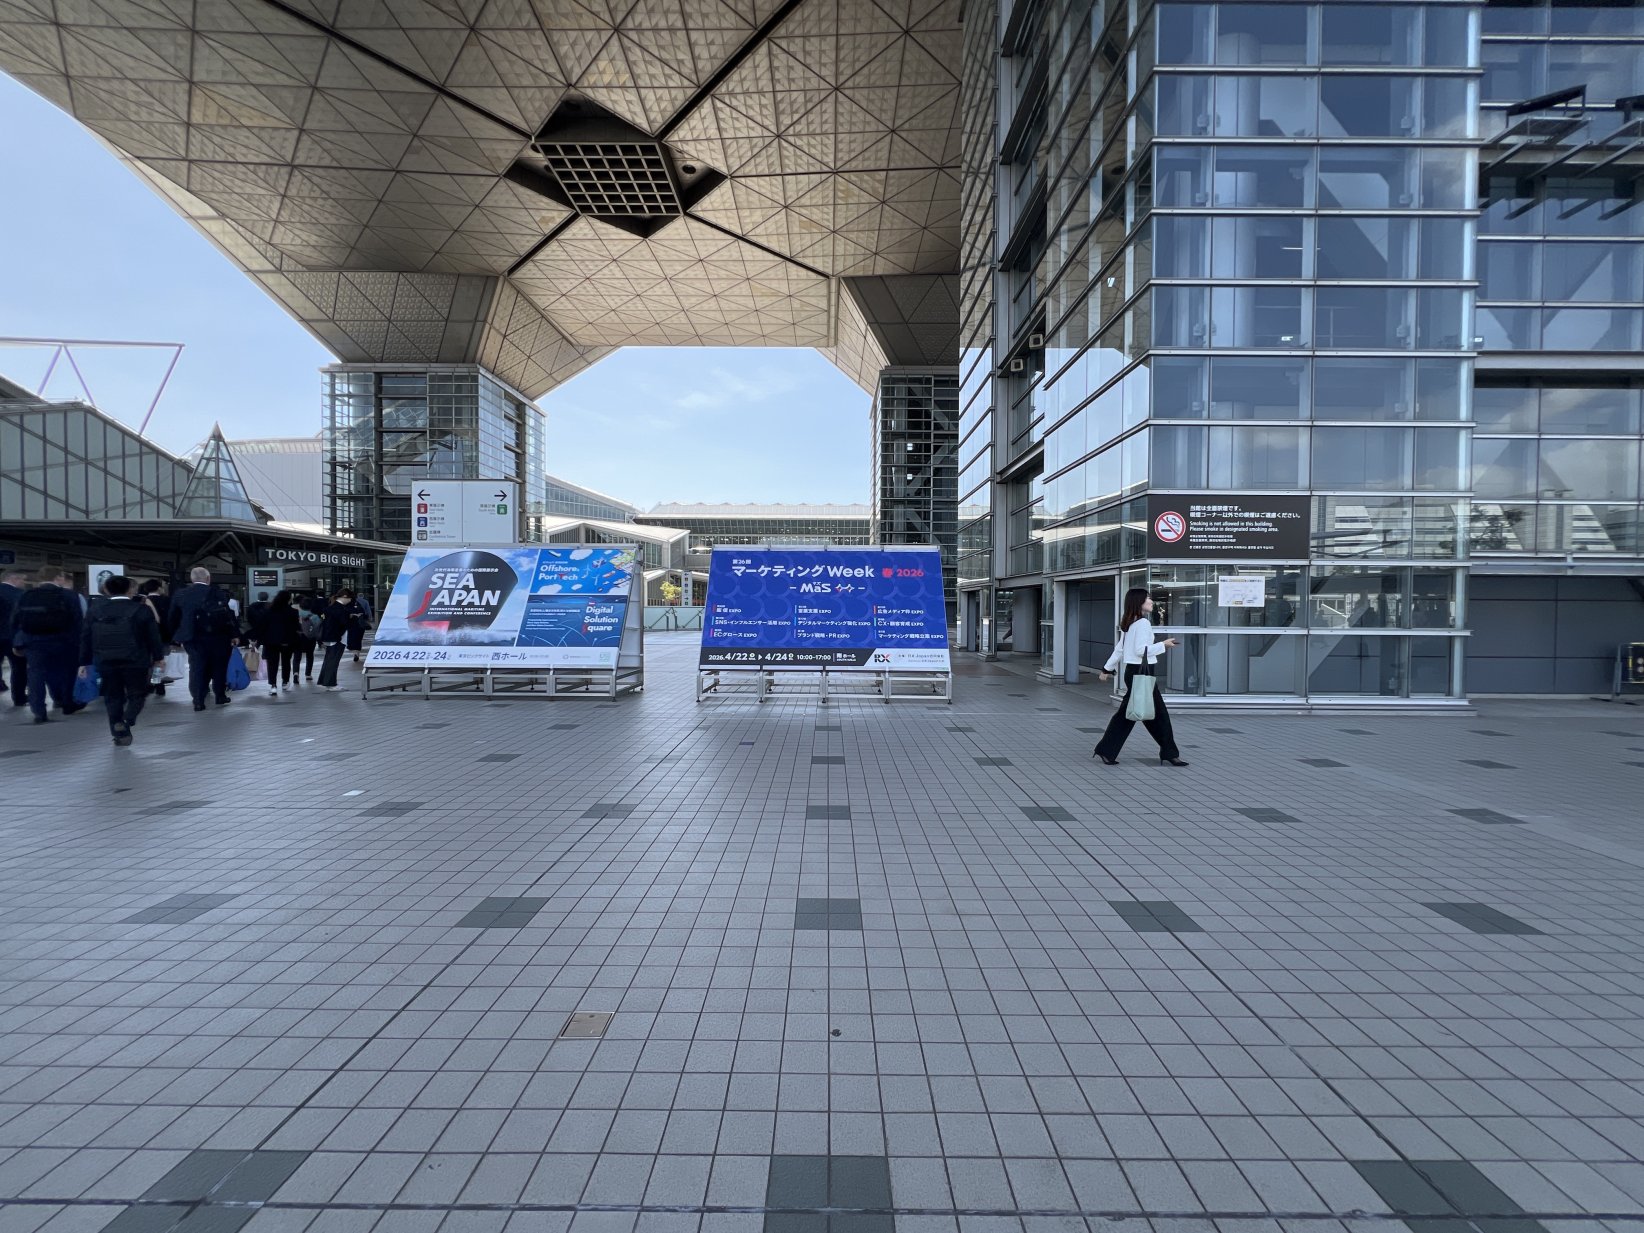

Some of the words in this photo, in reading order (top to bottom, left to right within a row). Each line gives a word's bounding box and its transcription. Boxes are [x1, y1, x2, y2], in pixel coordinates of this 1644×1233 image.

[265, 549, 316, 561] TOKYO
[320, 554, 338, 563] BIG
[342, 556, 365, 567] SIGHT
[429, 573, 475, 588] SEA
[800, 583, 831, 593] MaS
[405, 590, 501, 619] JAPAN
[874, 654, 891, 663] RX
